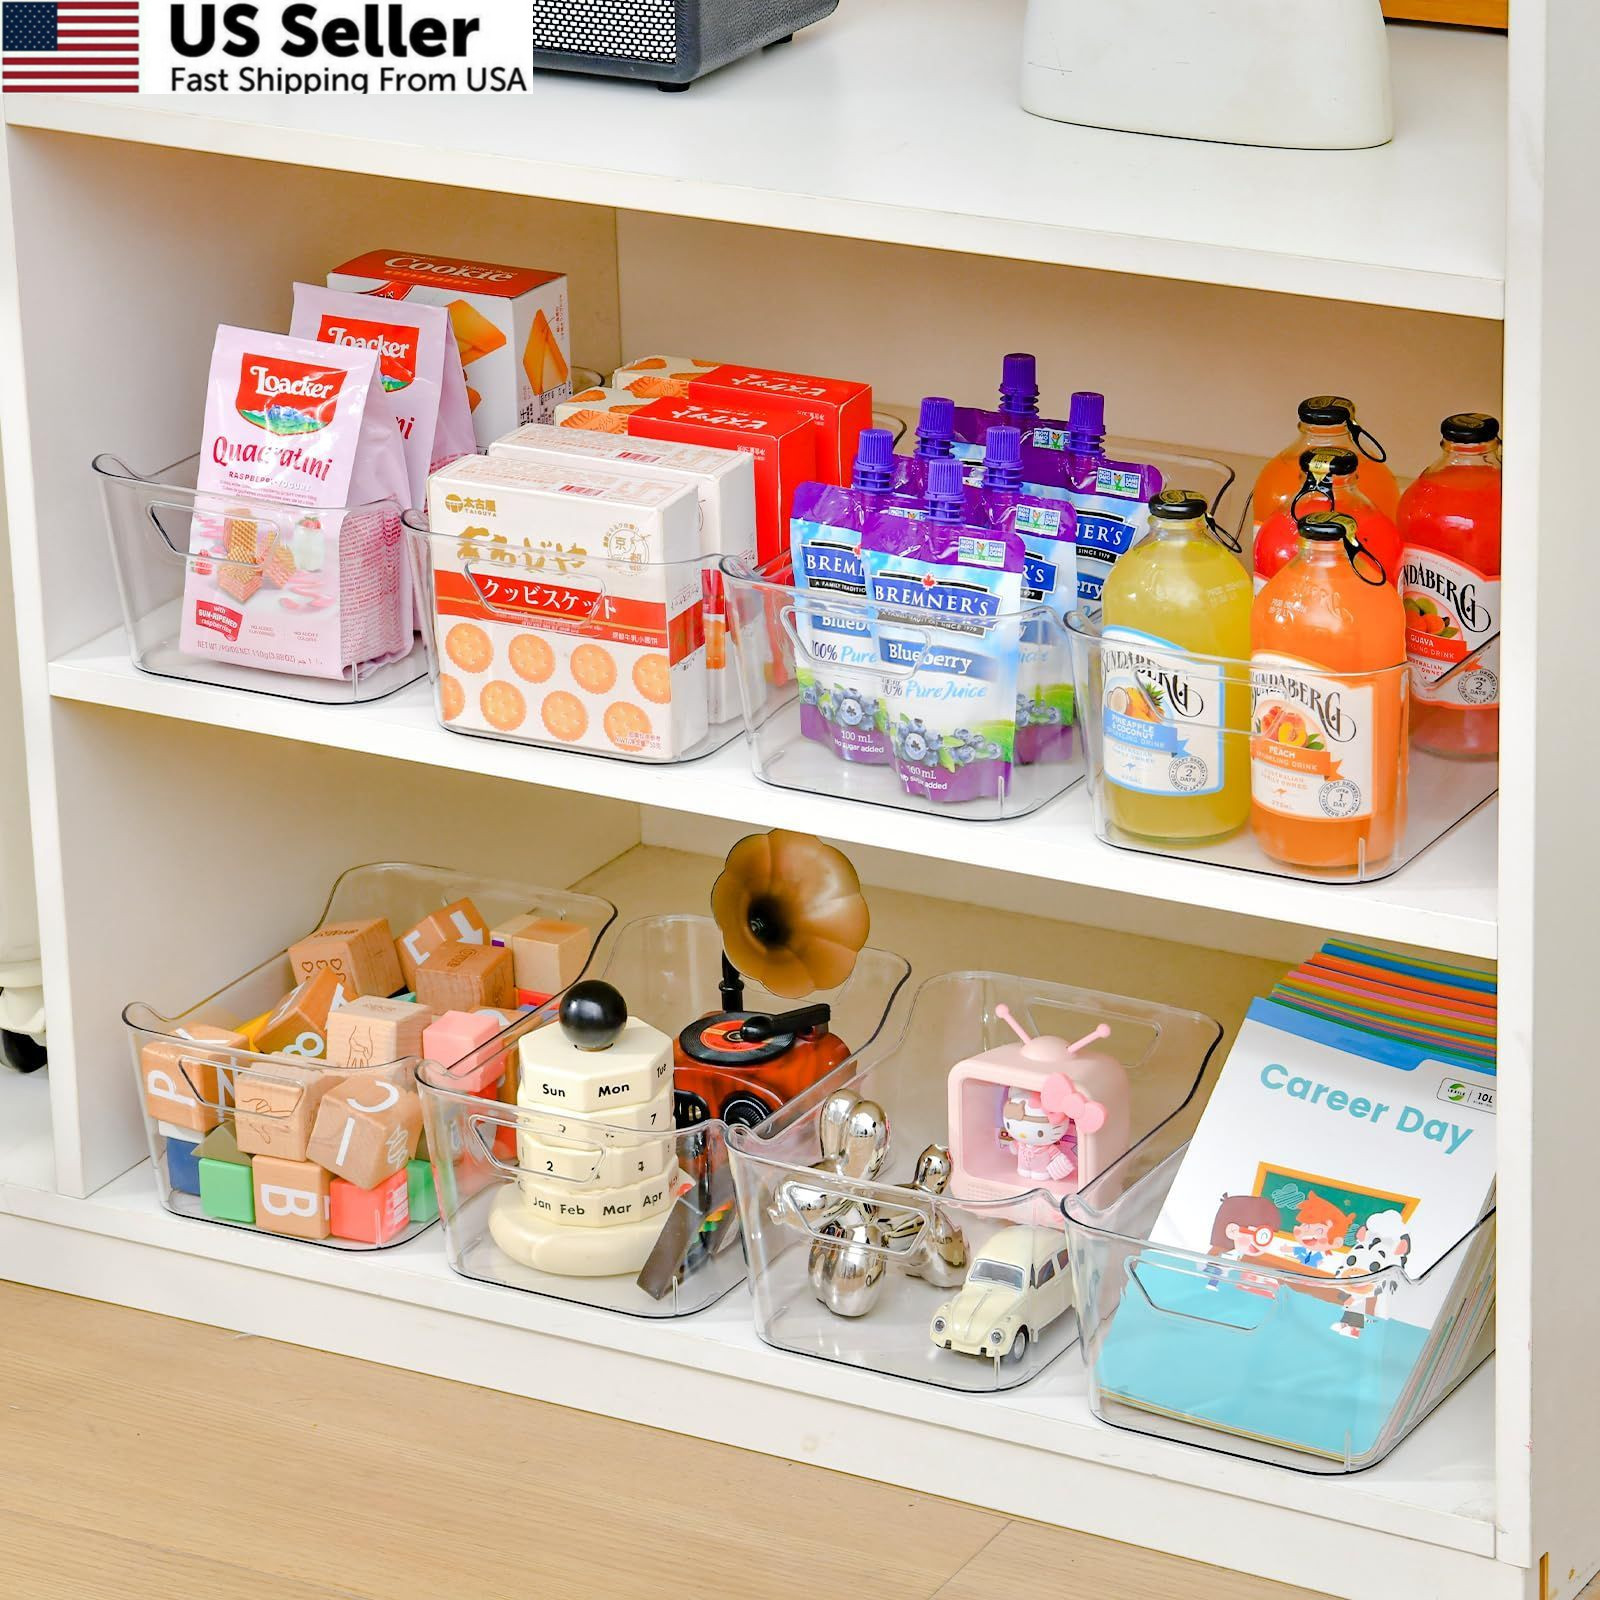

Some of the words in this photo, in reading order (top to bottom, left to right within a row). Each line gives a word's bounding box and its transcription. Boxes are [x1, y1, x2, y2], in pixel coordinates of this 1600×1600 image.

[385, 257, 512, 281] Cookie
[327, 327, 410, 359] Loacker
[250, 366, 334, 399] Loacker
[1078, 548, 1096, 556] SINCE
[1098, 551, 1111, 560] 1979
[874, 585, 989, 617] BREMNER'S
[213, 606, 226, 614] with
[198, 609, 238, 629] SUN-RIPENED
[201, 619, 232, 634] raspberries
[1410, 634, 1434, 648] GUAVA
[812, 640, 837, 660] 100%
[840, 646, 877, 663] Pure
[888, 643, 972, 674] Blueberry
[1430, 650, 1455, 659] DRINK
[905, 681, 943, 699] Pure
[944, 681, 987, 700] Juice
[1475, 681, 1483, 690] 2
[1111, 713, 1155, 733] PINEAPPLE
[840, 730, 856, 740] 100
[858, 734, 873, 744] mL
[1116, 723, 1155, 740] COCONUT
[834, 738, 842, 746] No
[842, 742, 860, 751] sugar
[861, 745, 884, 753] added
[1268, 746, 1296, 759] PEACH
[1185, 769, 1193, 777] 2
[1292, 761, 1318, 771] DRINK
[921, 770, 937, 780] mL
[924, 781, 948, 790] added
[1338, 793, 1344, 802] 1
[542, 1083, 566, 1098] Sun
[597, 1082, 630, 1098] Mon
[656, 1063, 667, 1078] Tue
[147, 1070, 196, 1108] P
[1260, 1063, 1390, 1123] Career
[1395, 1105, 1475, 1155] Day
[651, 1113, 657, 1126] 7
[546, 1160, 554, 1172] 2
[260, 1183, 318, 1217] B
[533, 1197, 552, 1211] Jan
[560, 1204, 585, 1215] Feb
[602, 1203, 632, 1216] Mar
[643, 1191, 663, 1208] Apr
